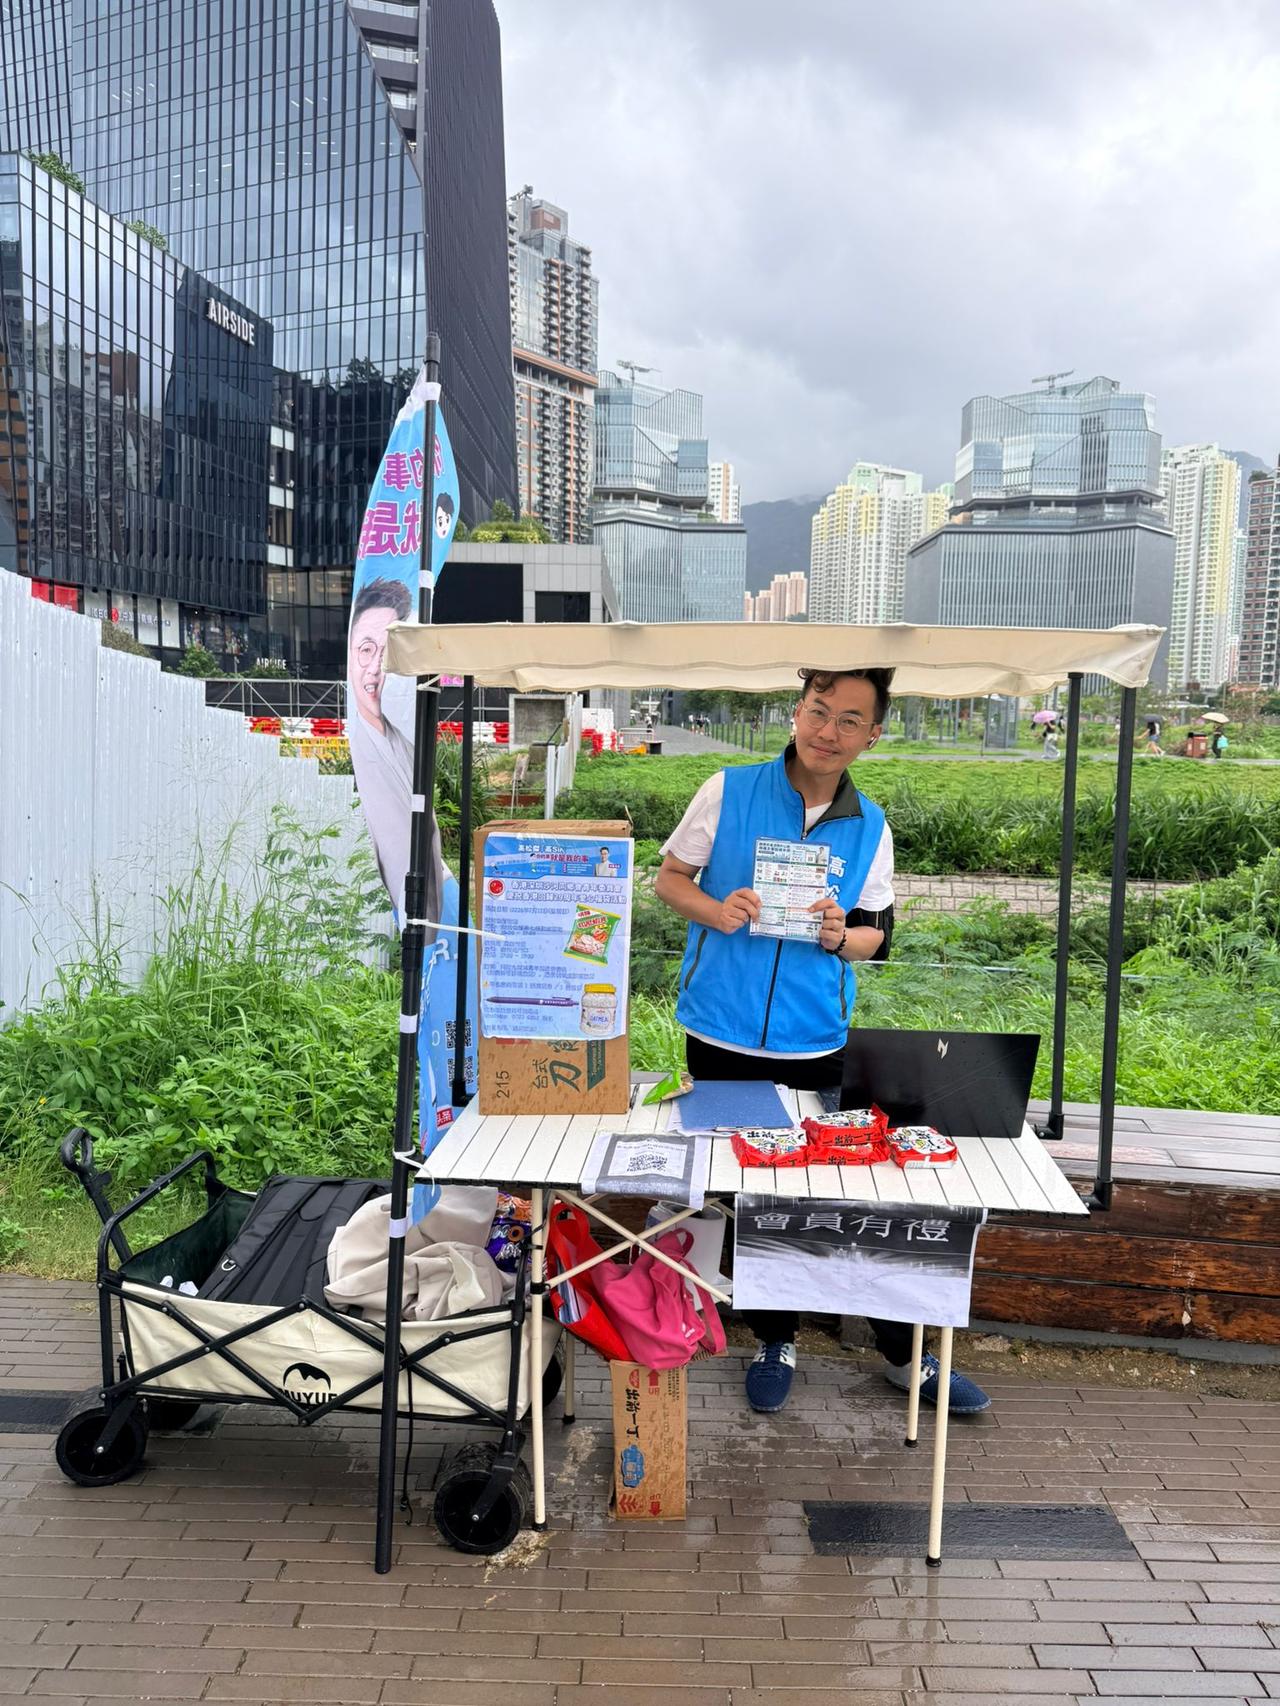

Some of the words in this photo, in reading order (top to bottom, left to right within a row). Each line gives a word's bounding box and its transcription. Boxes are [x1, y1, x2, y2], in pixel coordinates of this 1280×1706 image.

[207, 297, 255, 346] AIRSIDE
[496, 1070, 511, 1099] 215
[532, 1057, 549, 1089] 台式
[754, 1212, 951, 1242] 會員有禮
[625, 1387, 640, 1439] 出前一丁
